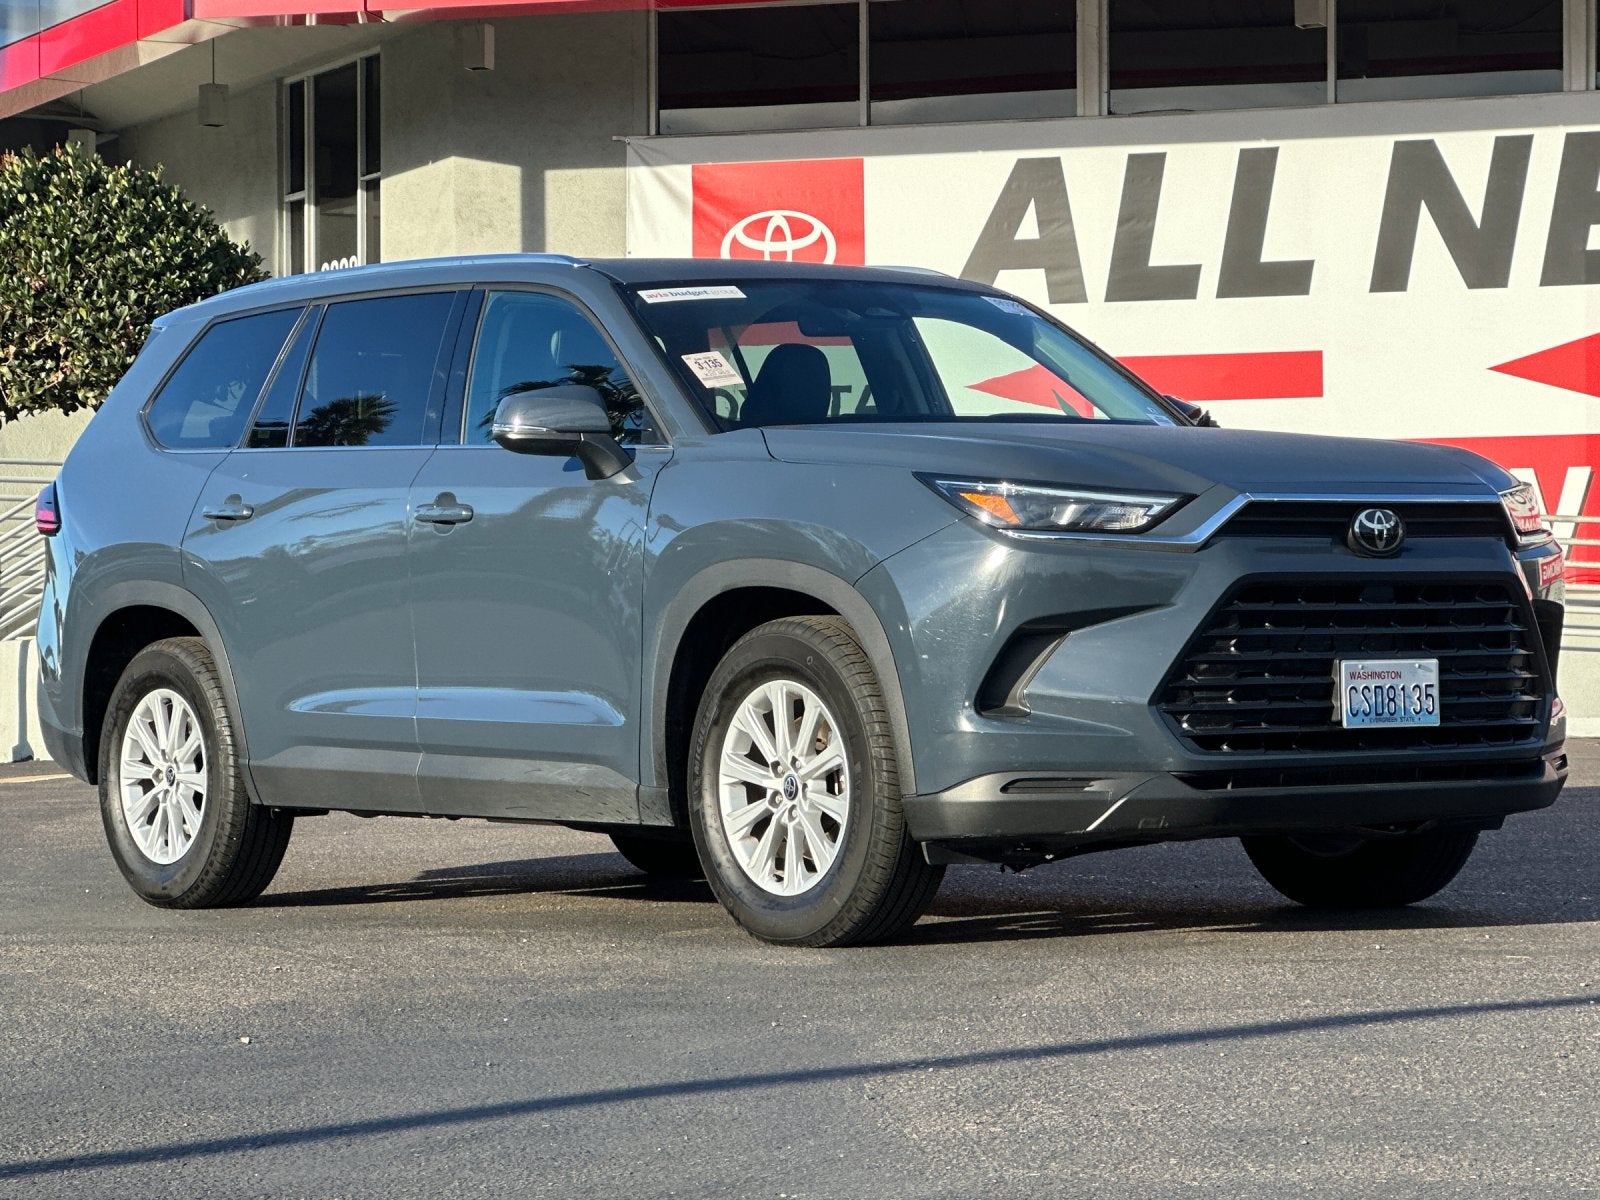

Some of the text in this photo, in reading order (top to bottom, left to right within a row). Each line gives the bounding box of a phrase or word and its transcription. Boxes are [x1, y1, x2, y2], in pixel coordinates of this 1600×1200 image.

[959, 146, 1315, 304] ALL
[645, 290, 669, 299] avis
[668, 289, 710, 298] budget
[1349, 671, 1402, 680] WASHINGTON
[1348, 683, 1435, 718] CSD8135
